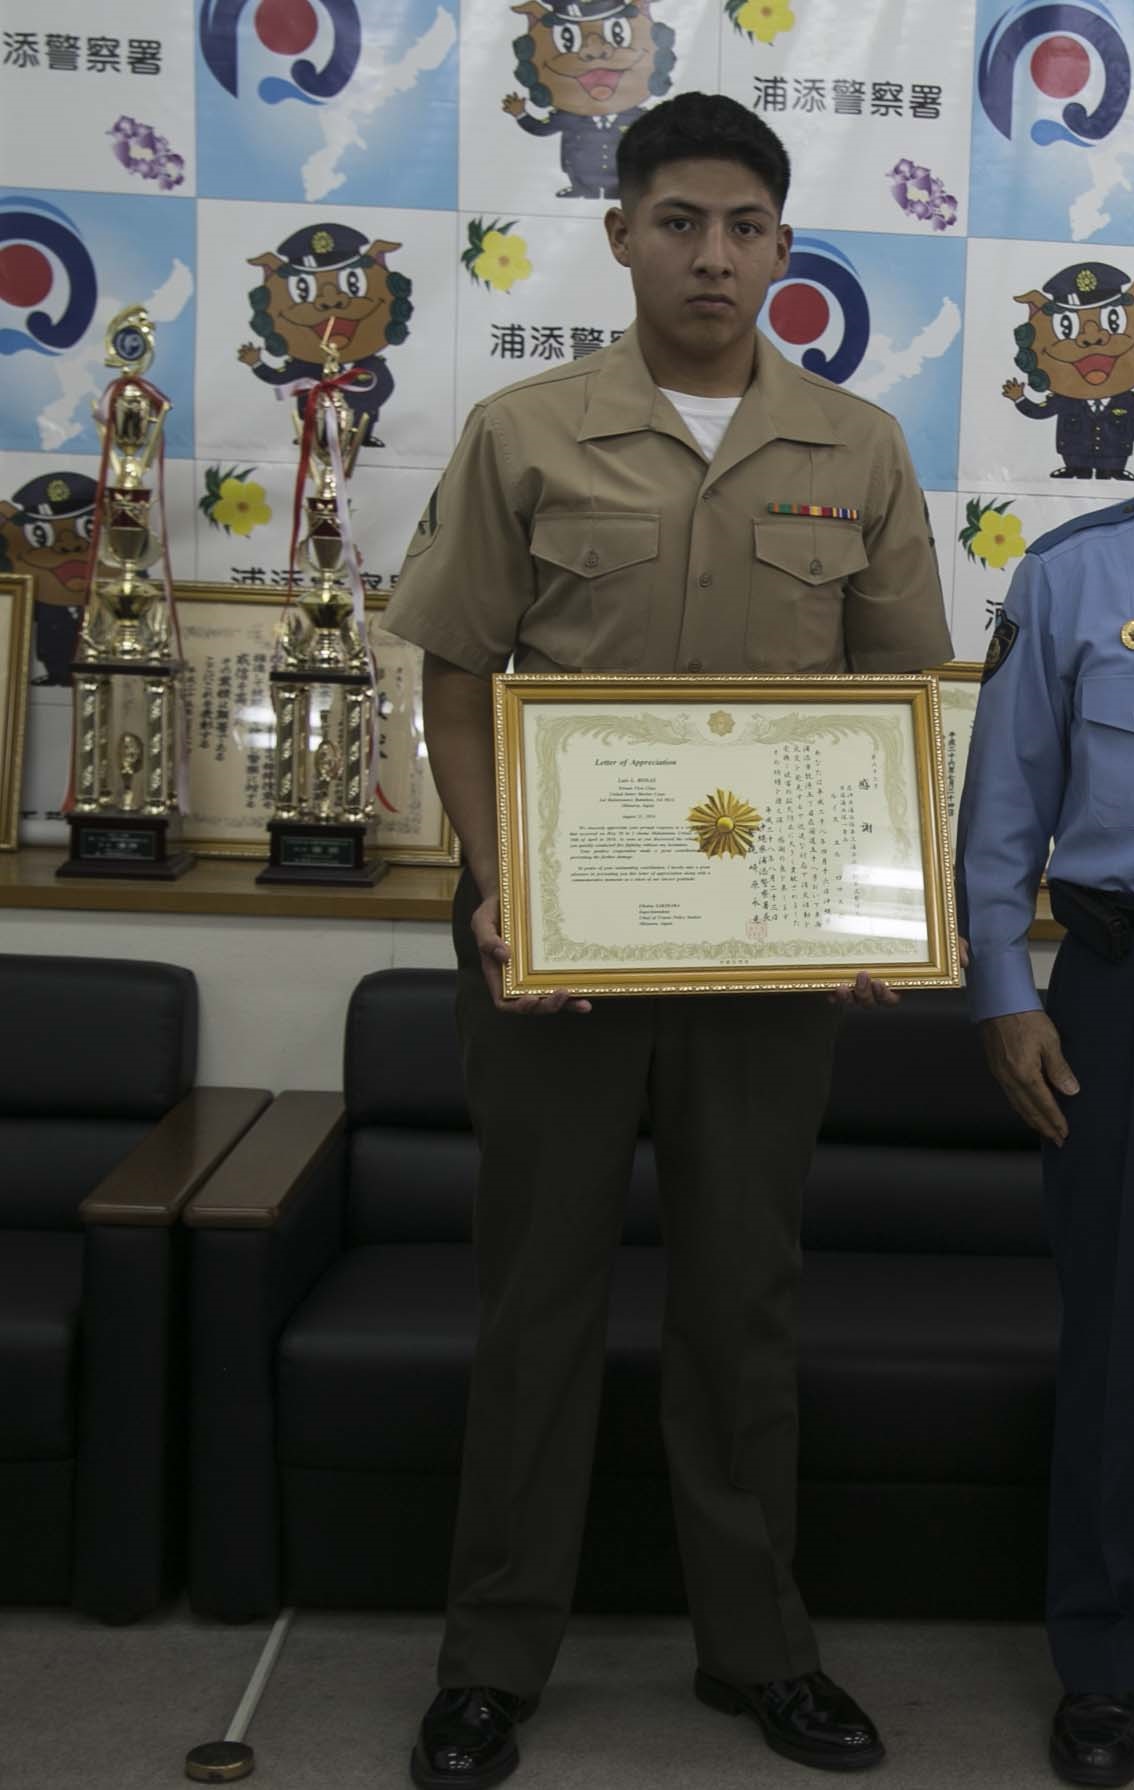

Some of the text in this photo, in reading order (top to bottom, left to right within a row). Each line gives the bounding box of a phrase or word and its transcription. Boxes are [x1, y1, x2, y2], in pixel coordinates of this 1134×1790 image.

[3, 31, 163, 76] 添警察署
[753, 75, 942, 120] 浦添警察署
[490, 323, 625, 361] 浦添警
[594, 758, 677, 768] Letter of Appreciation
